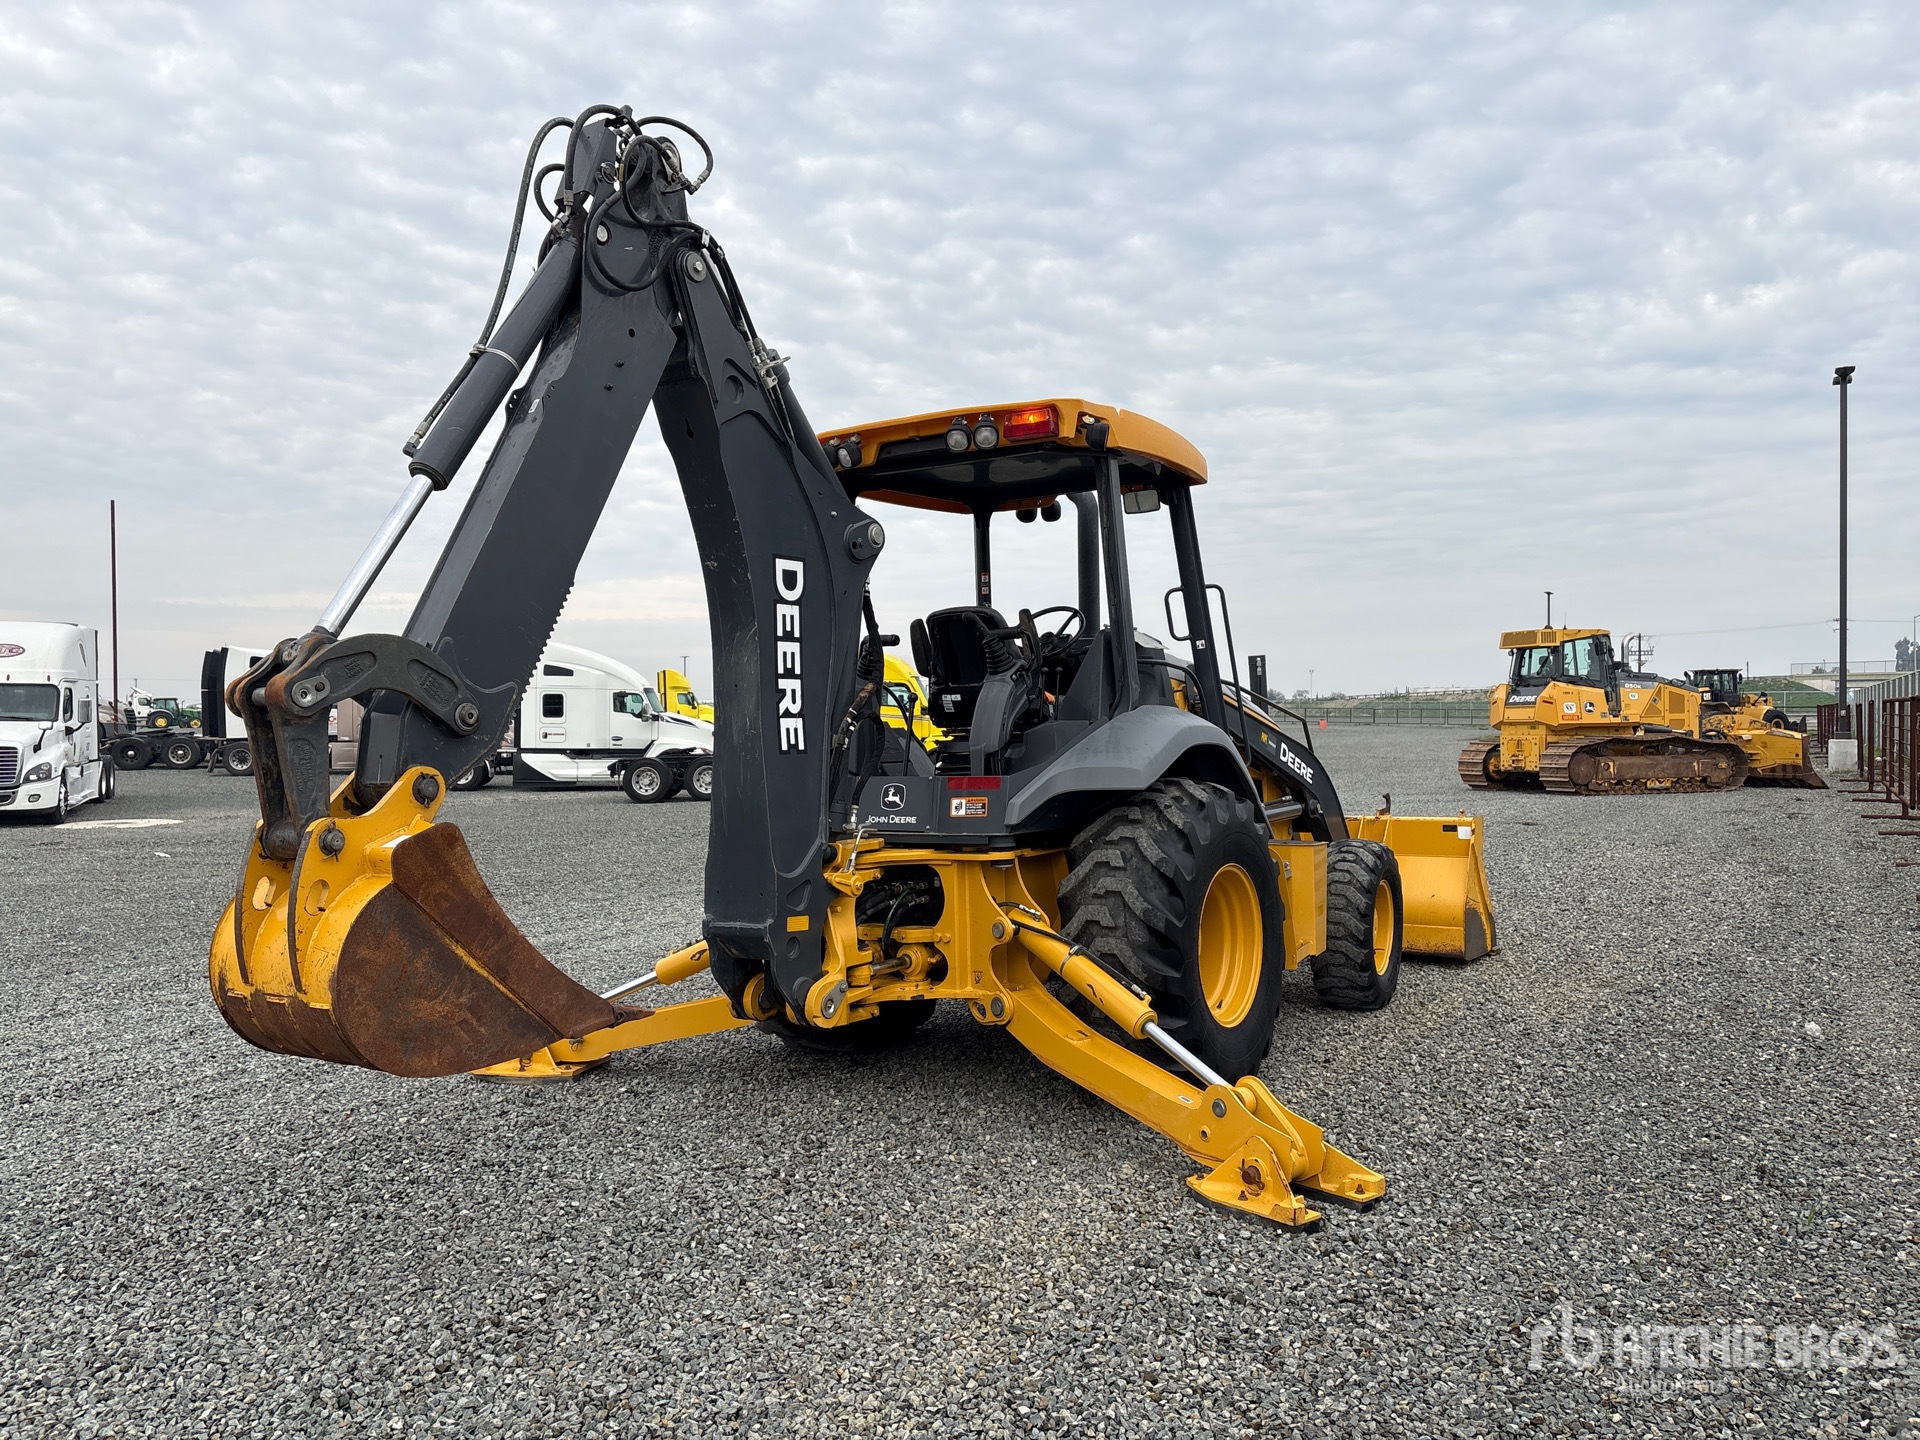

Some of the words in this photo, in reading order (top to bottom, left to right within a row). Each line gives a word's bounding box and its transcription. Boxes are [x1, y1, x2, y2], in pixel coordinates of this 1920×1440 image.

[775, 558, 805, 750] DEERE
[1279, 742, 1313, 784] DEERE
[865, 815, 888, 824] JOHN
[889, 815, 917, 823] DEERE
